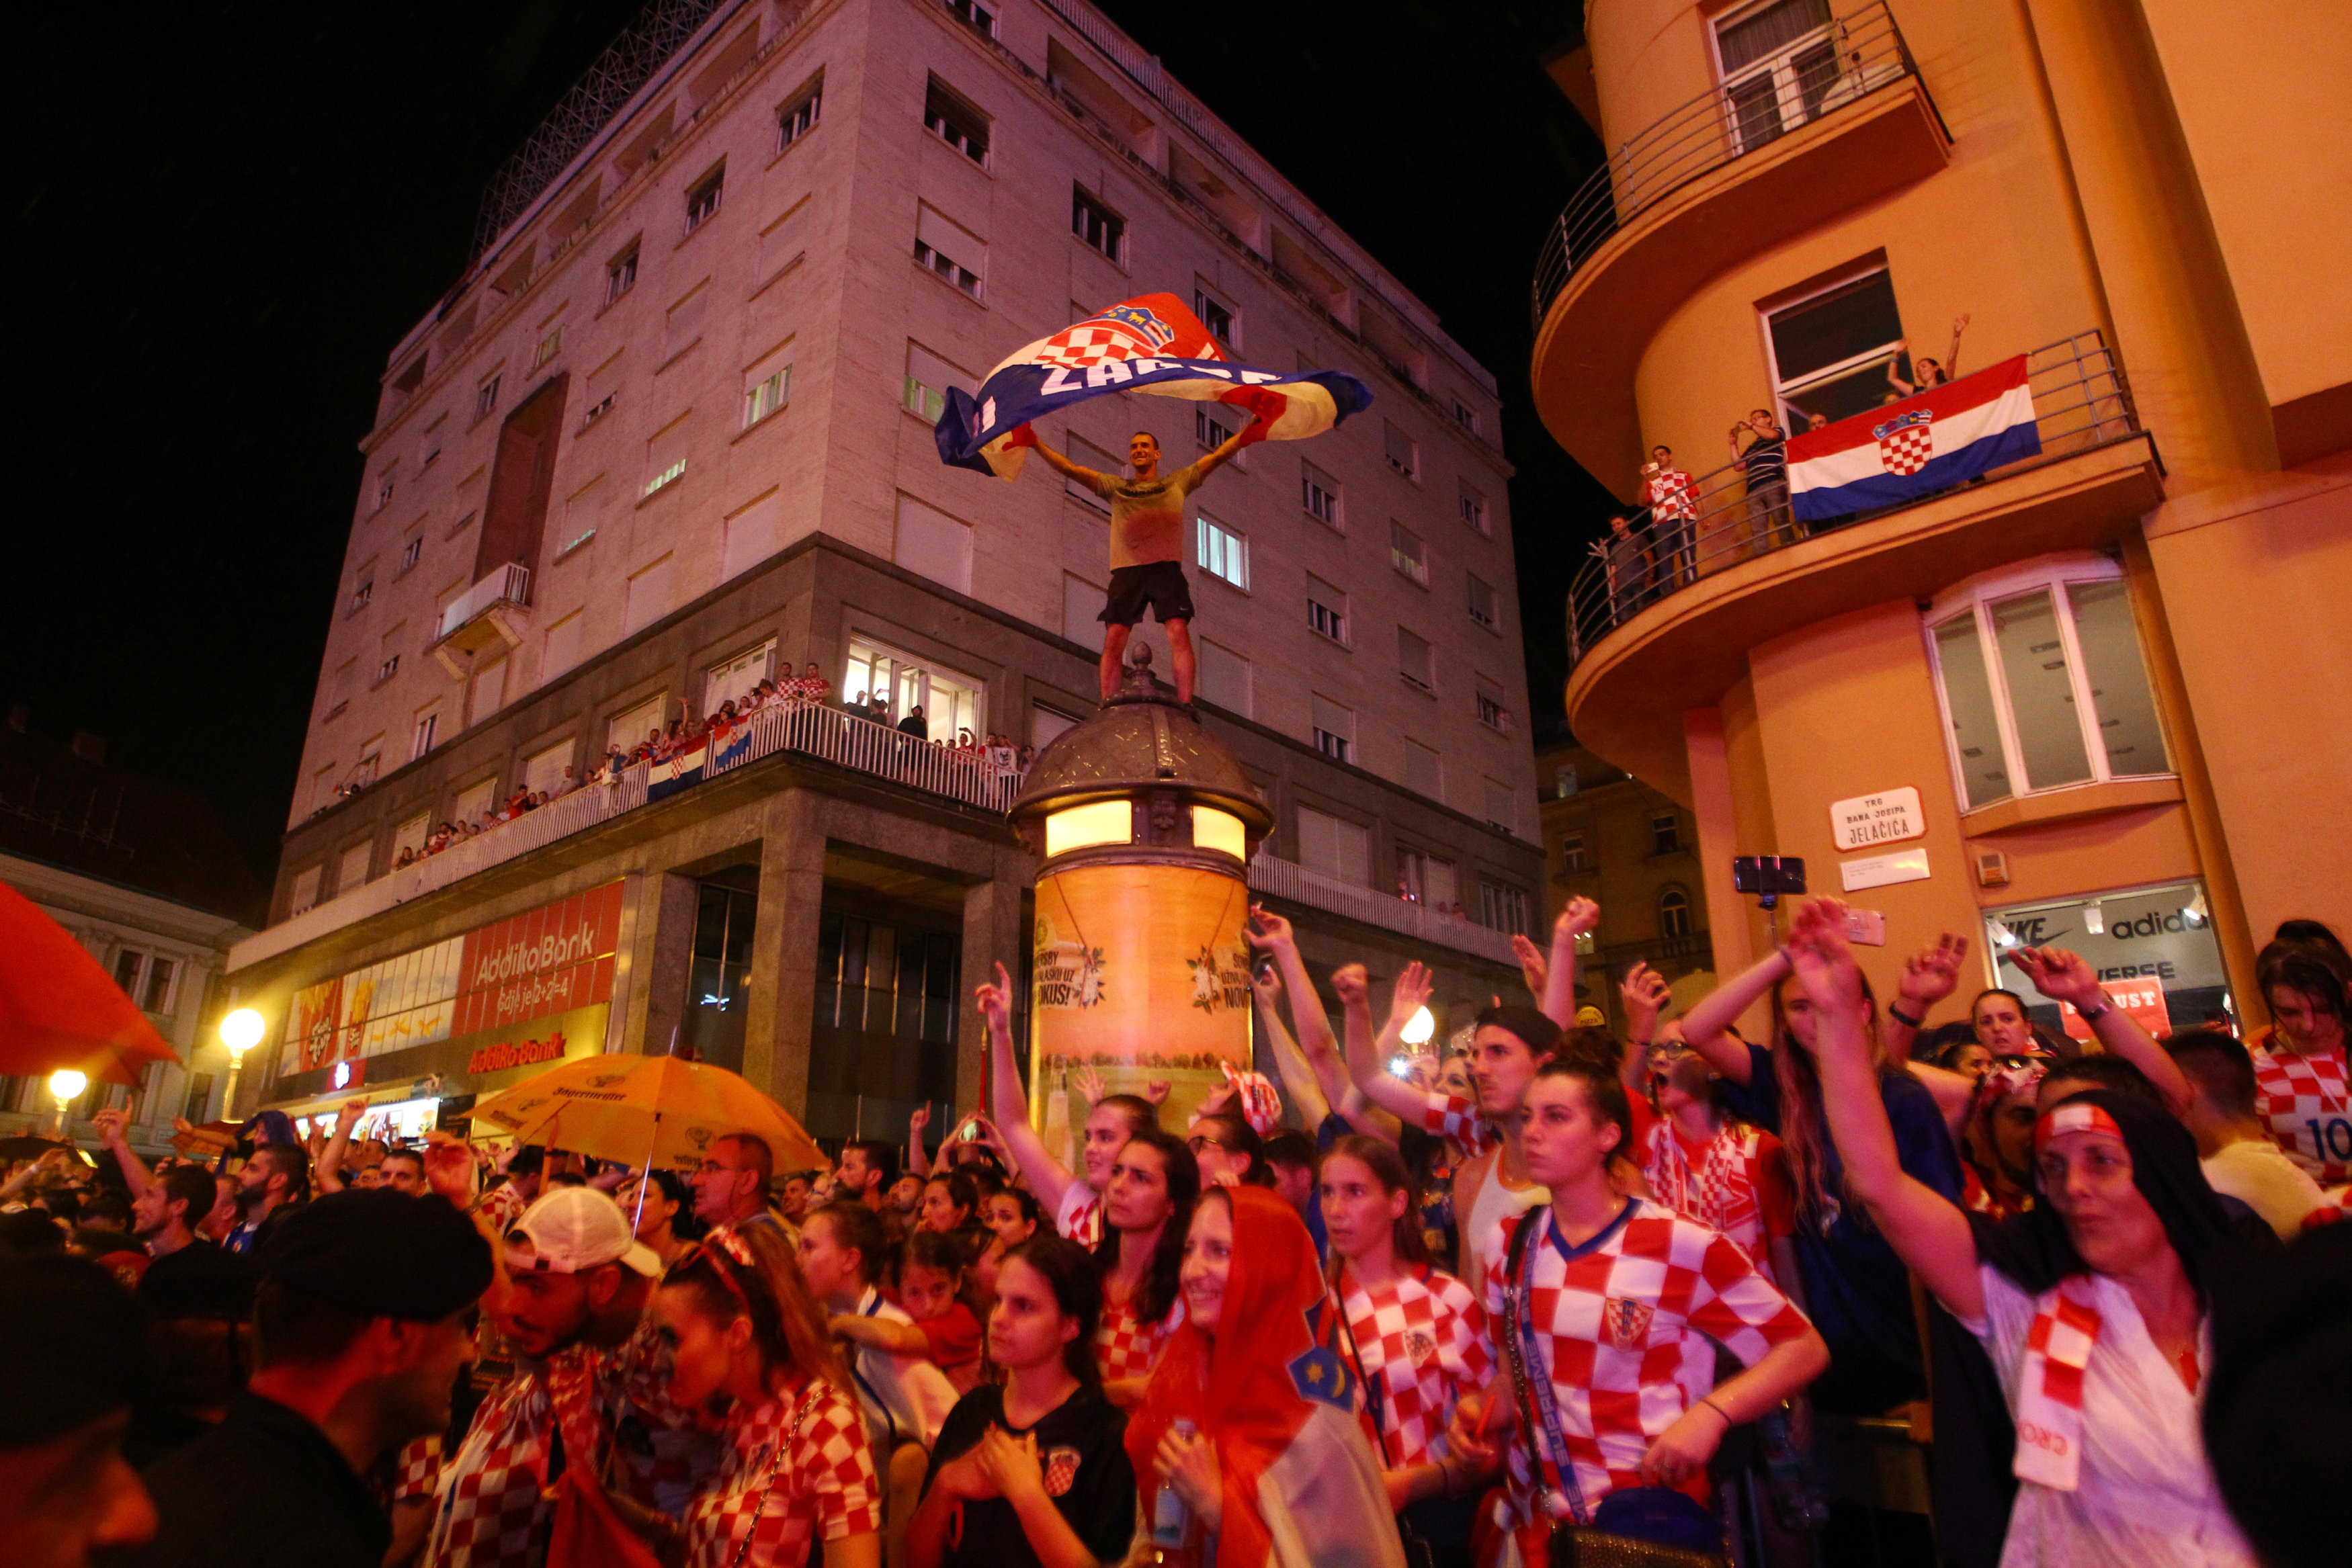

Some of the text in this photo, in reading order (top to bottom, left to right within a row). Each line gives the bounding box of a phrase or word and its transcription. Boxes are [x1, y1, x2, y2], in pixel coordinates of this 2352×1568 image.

[1847, 806, 1906, 824] BANA JOSIPA
[1865, 798, 1883, 808] TRG
[1850, 818, 1910, 844] JELAČIĆA
[1994, 918, 2046, 947] IKE
[2112, 908, 2209, 940] adida
[476, 921, 595, 986] Addiko Bank
[468, 1033, 566, 1074] Addiko Bank
[2306, 1118, 2352, 1162] 10
[1527, 1341, 1571, 1467] SUPREME
